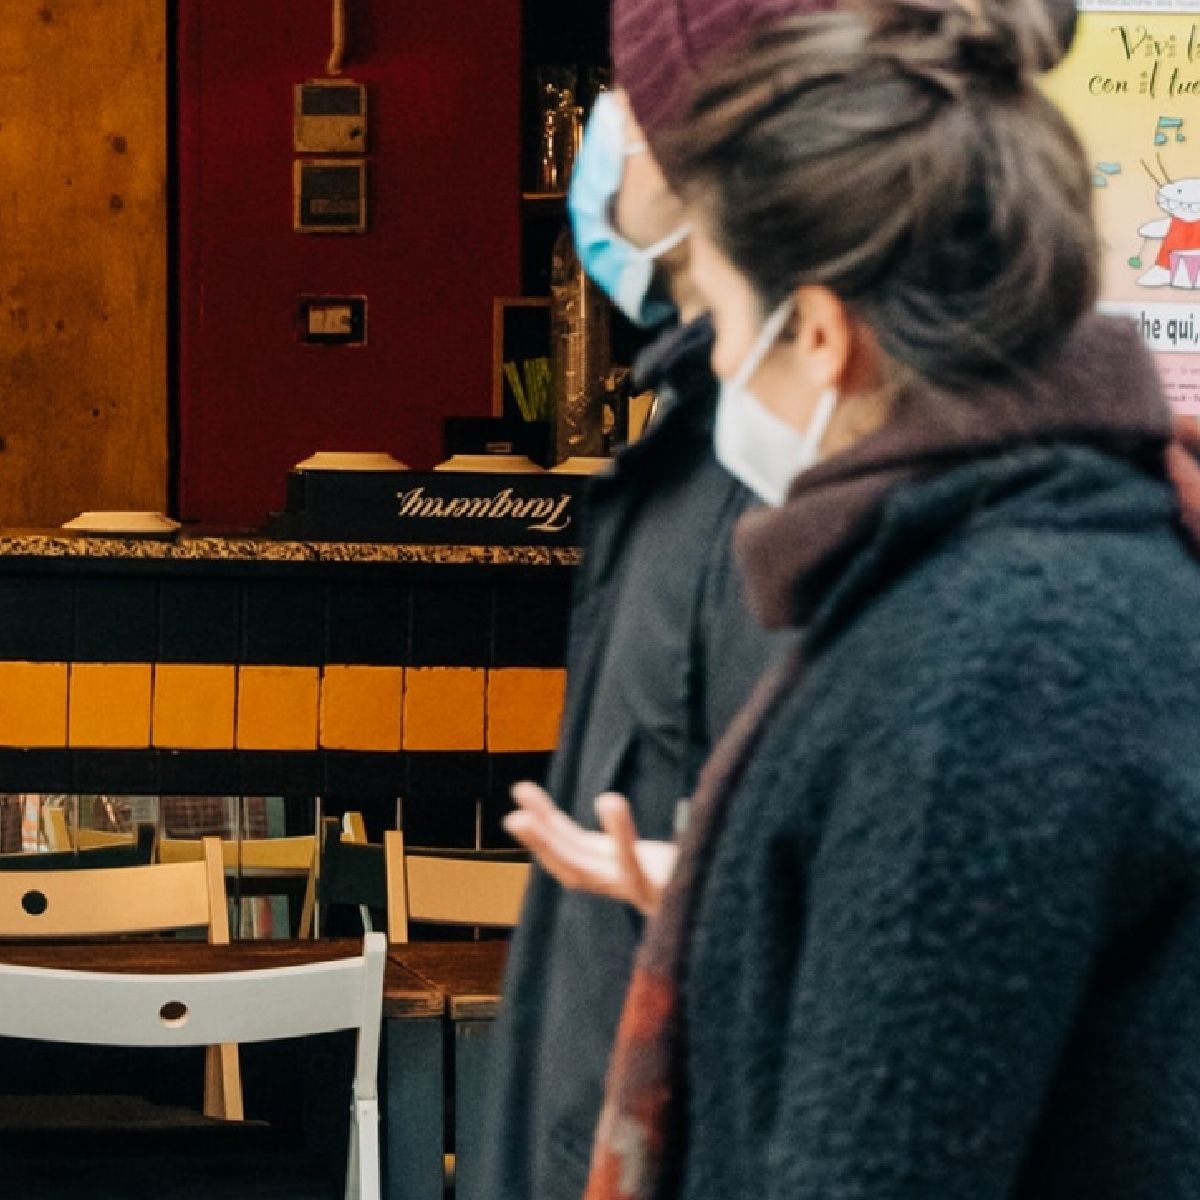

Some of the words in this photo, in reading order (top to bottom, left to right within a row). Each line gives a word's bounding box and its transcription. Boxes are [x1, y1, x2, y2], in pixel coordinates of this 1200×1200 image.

[1111, 25, 1176, 60] Vivi
[1089, 74, 1128, 96] con
[1139, 60, 1158, 99] il
[1167, 313, 1199, 345] qui,
